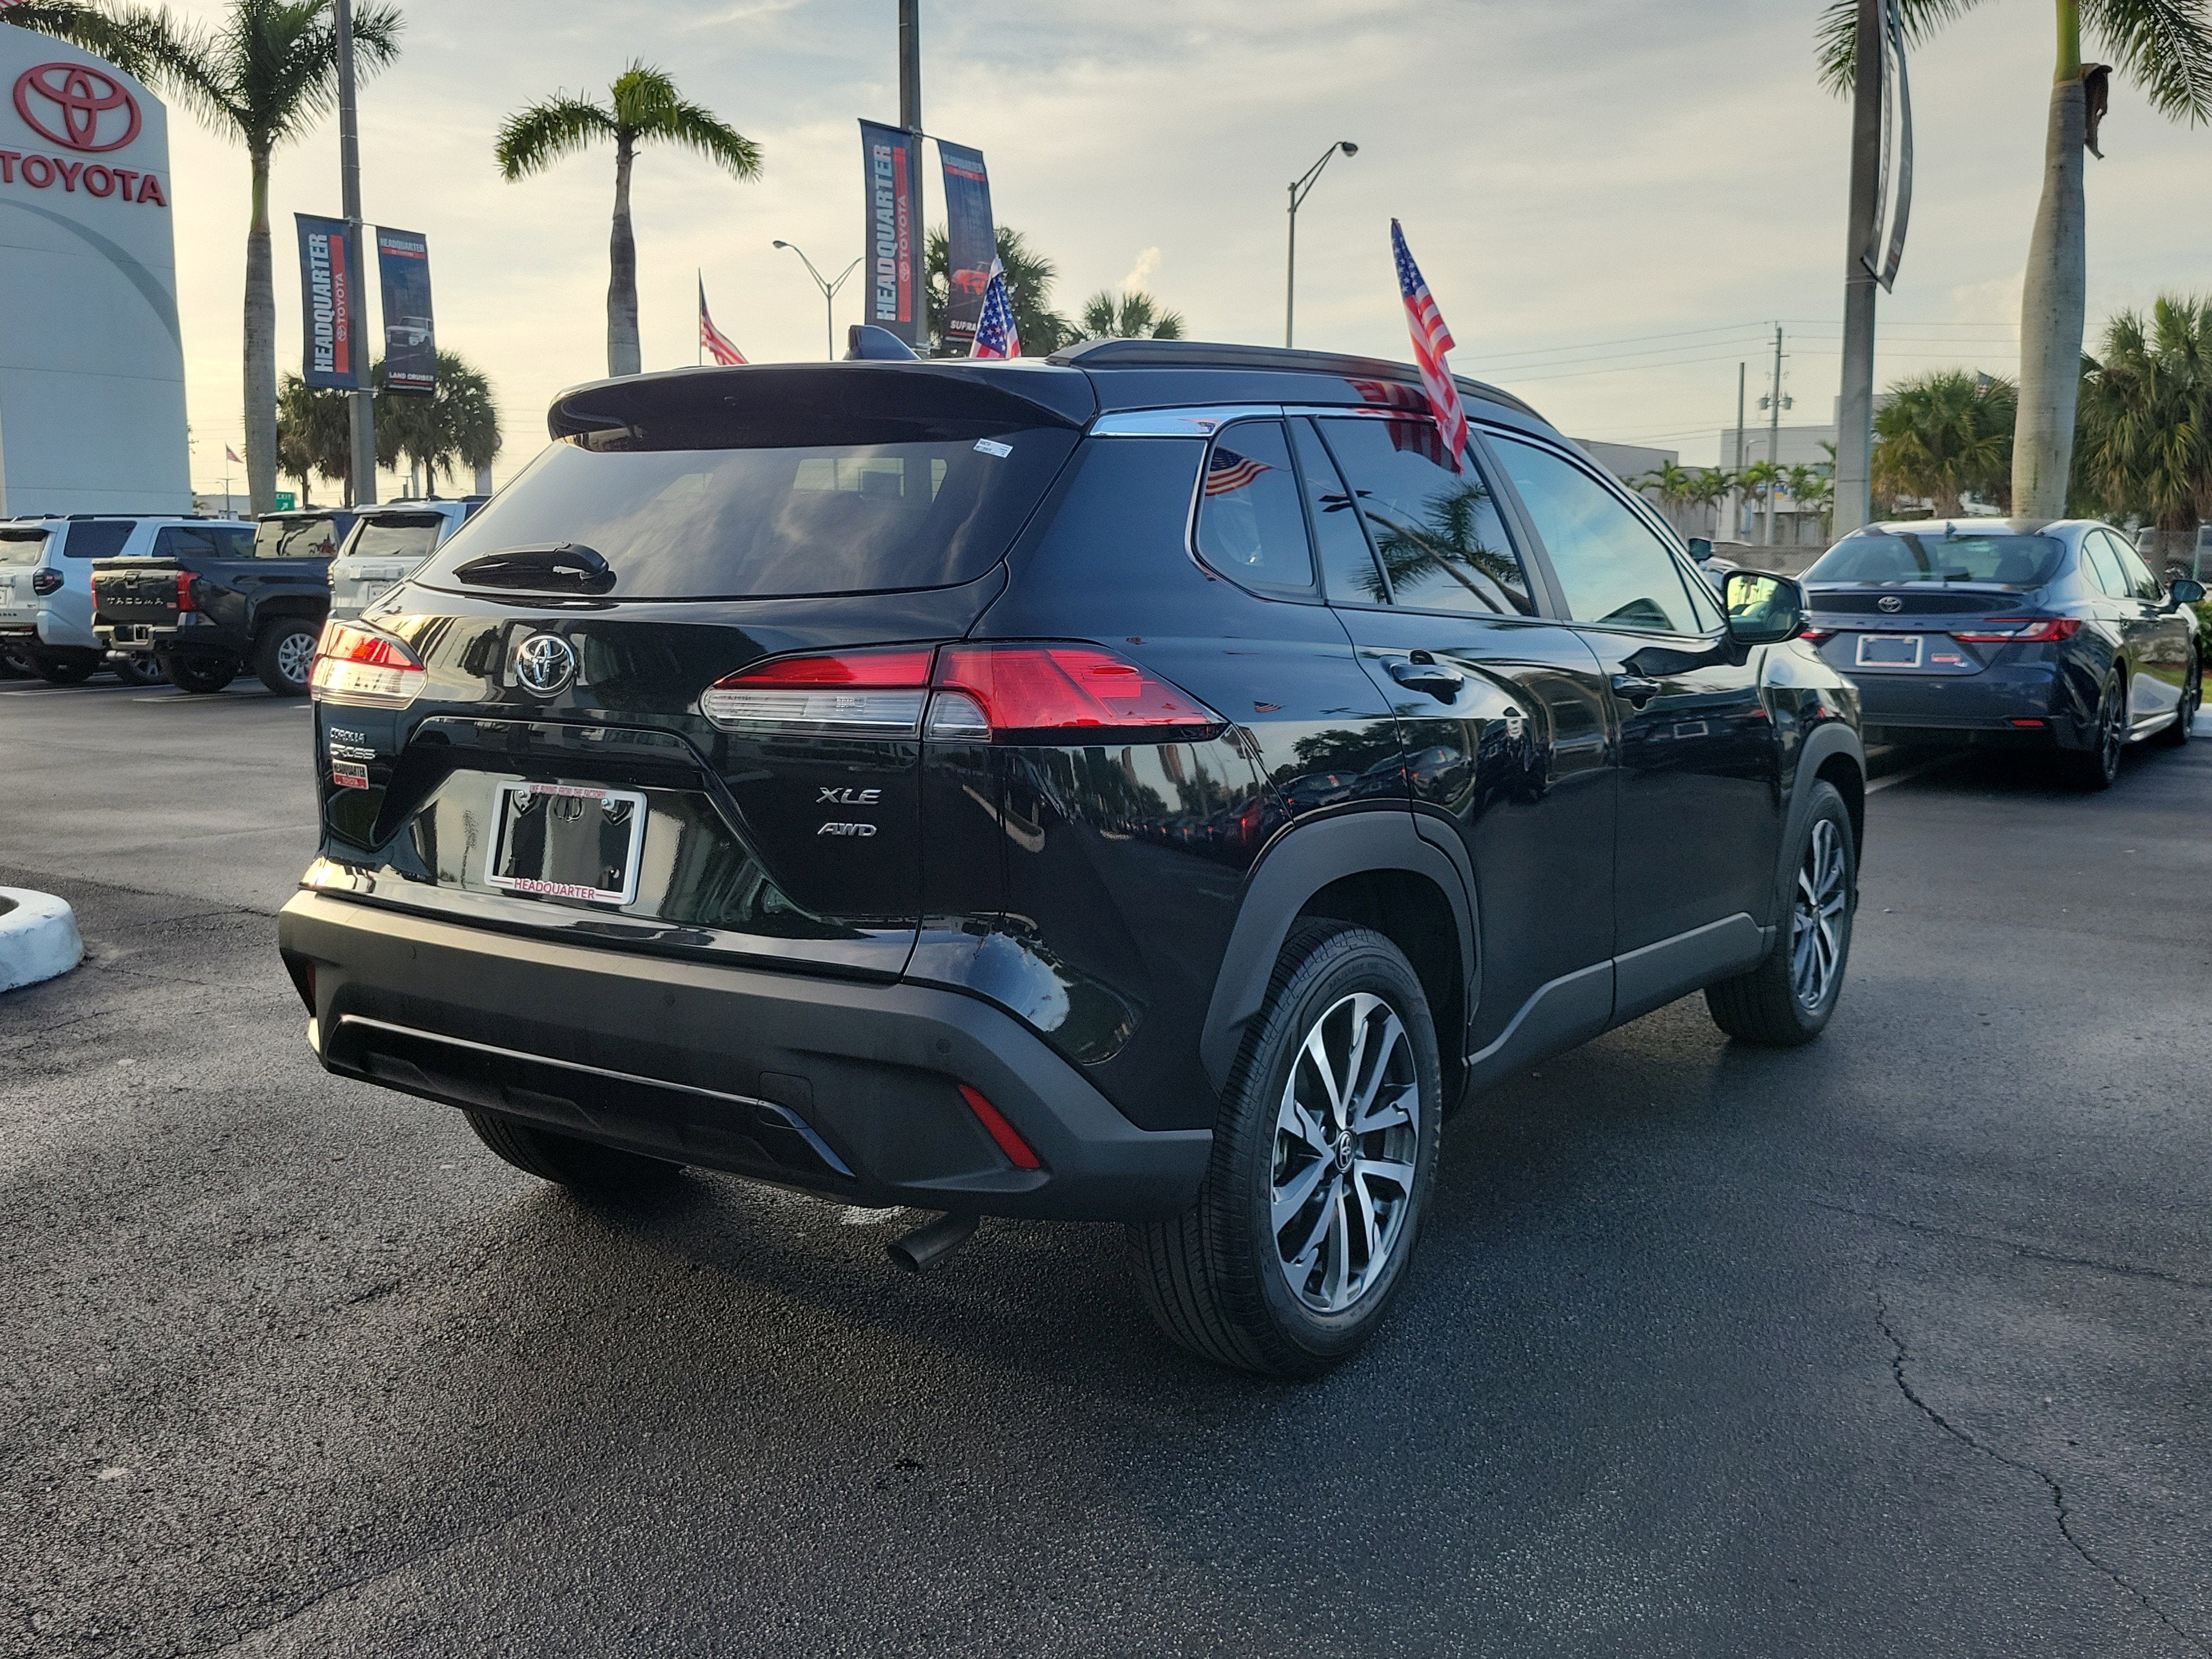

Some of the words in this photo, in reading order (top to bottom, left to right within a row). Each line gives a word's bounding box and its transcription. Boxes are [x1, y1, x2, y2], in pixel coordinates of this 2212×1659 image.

[0, 150, 167, 207] TOYOTA
[874, 144, 898, 321] HEADQUARTER
[898, 195, 908, 261] TOYOTA
[308, 233, 335, 373] HEADQUARTER
[335, 273, 347, 323] TOYOTA
[950, 320, 977, 331] SUPRA
[106, 597, 163, 605] TACOMA
[330, 742, 376, 760] CROSS
[815, 787, 882, 805] XLE
[817, 822, 877, 837] AWD
[514, 879, 595, 899] HEADQUARTER
